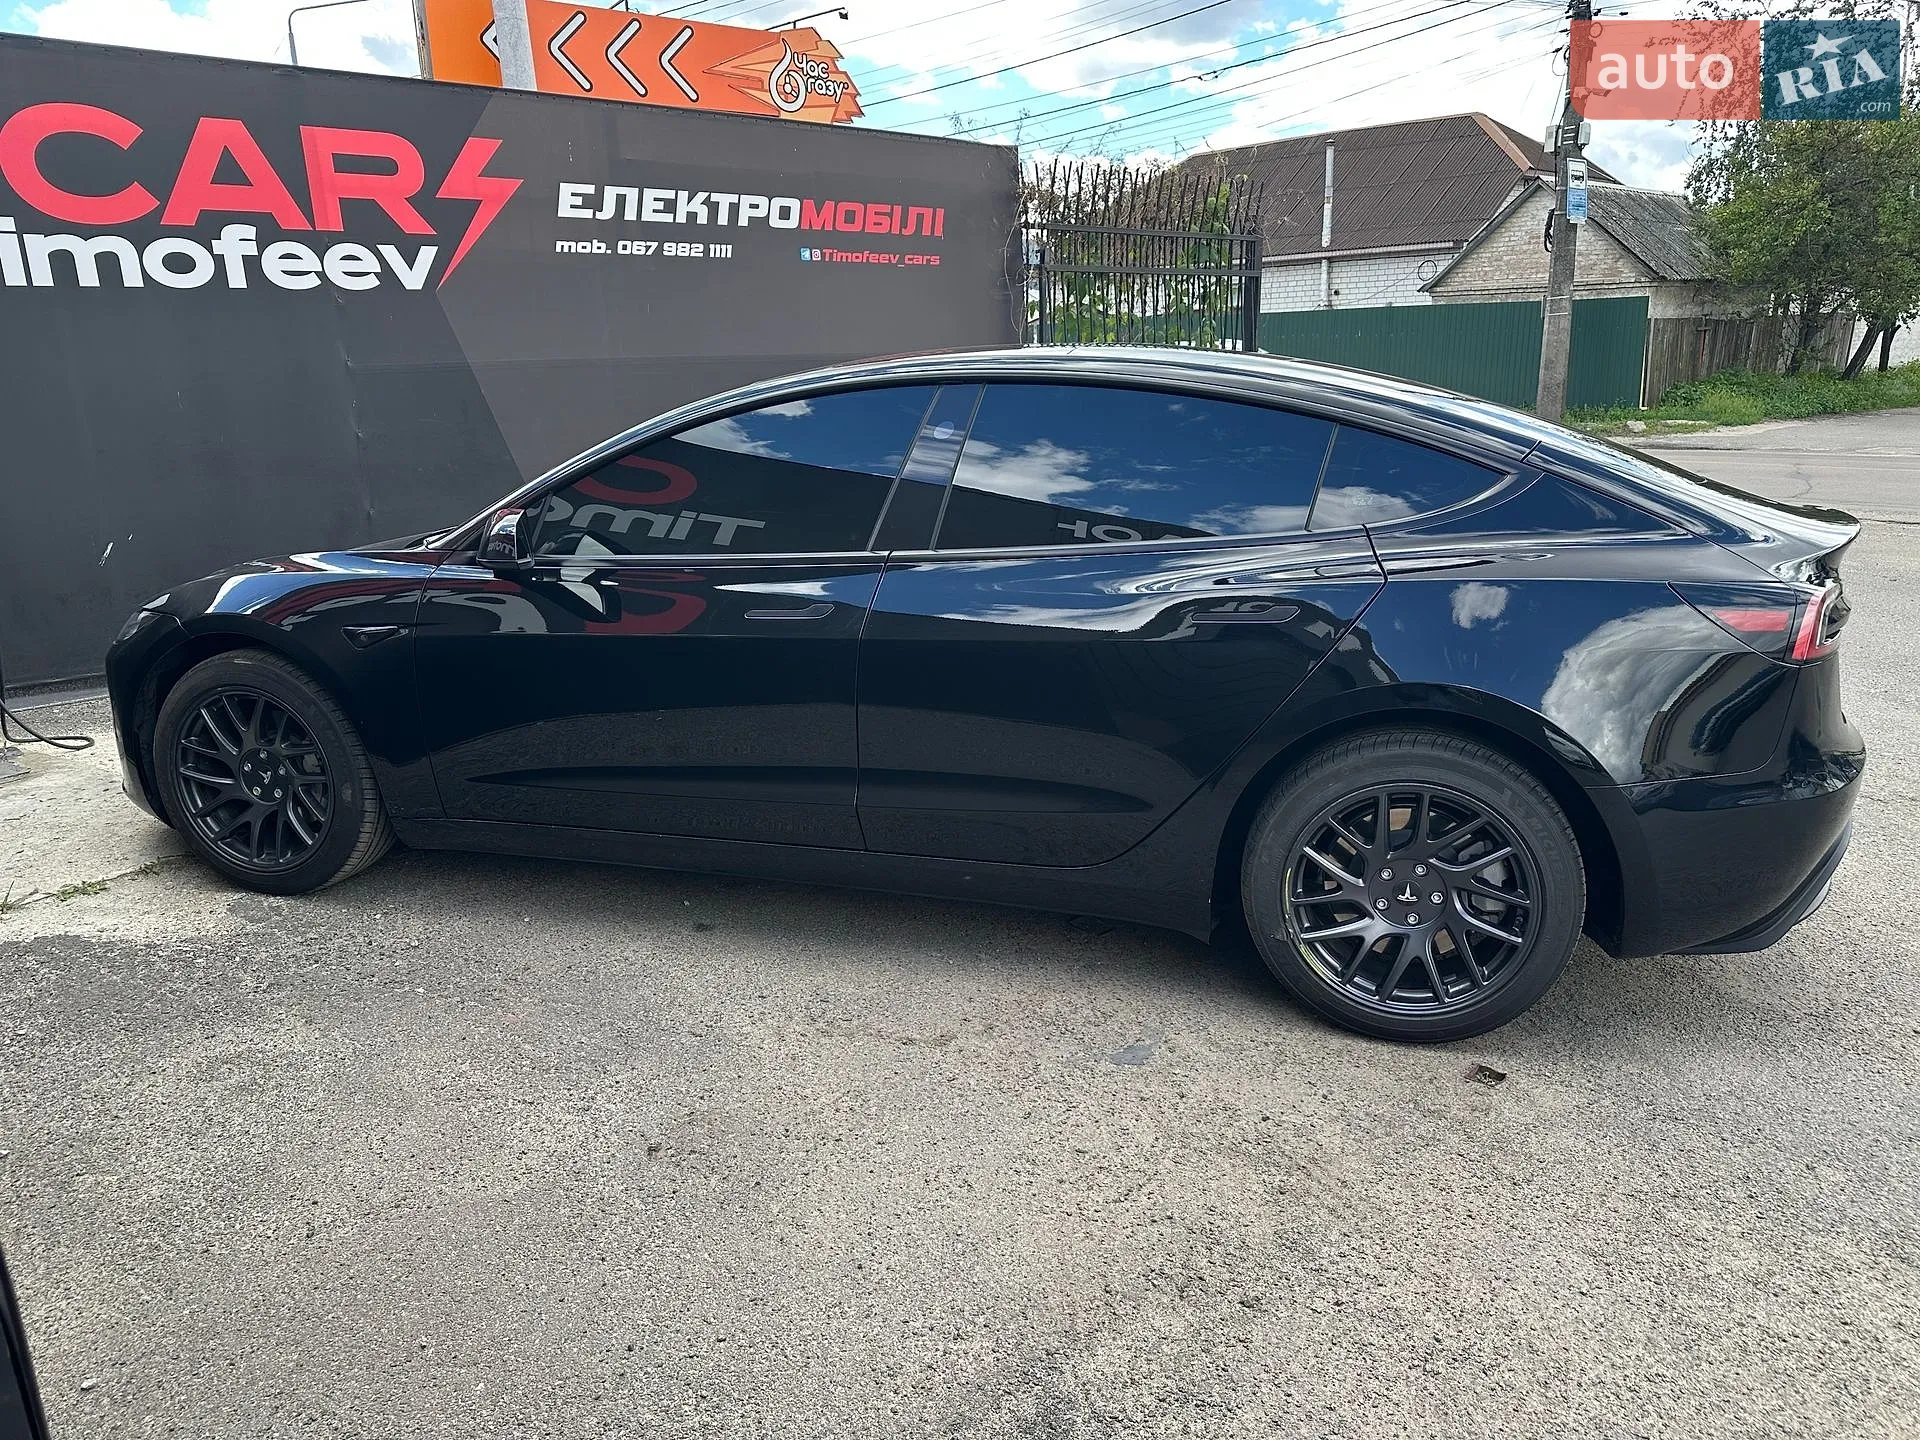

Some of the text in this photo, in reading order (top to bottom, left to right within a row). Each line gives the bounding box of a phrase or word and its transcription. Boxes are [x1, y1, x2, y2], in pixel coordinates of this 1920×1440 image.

[793, 52, 829, 79] Час
[806, 77, 844, 103] газу
[557, 182, 944, 238] ЕЛЕКТРОМОБІЛІ
[555, 239, 733, 259] mob. 067 982 1111
[822, 248, 941, 267] Timofeev_cars
